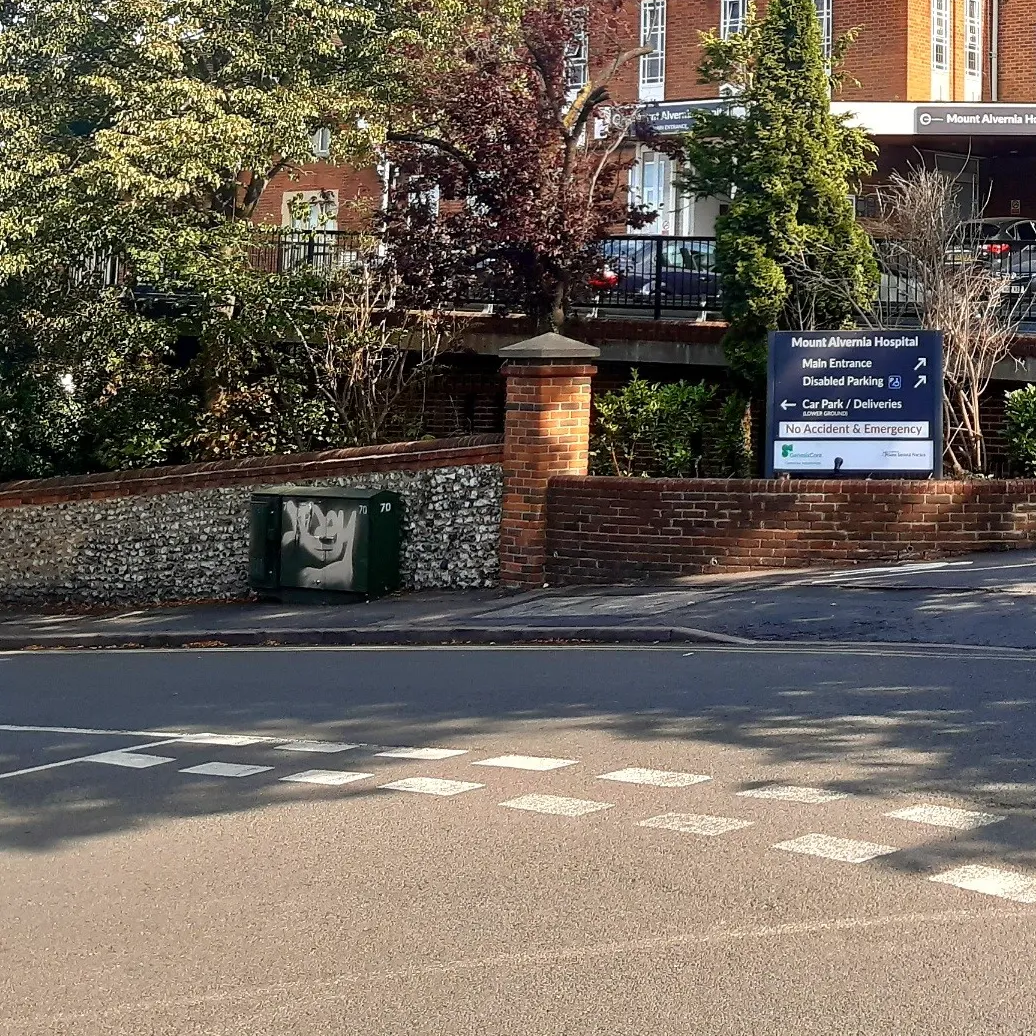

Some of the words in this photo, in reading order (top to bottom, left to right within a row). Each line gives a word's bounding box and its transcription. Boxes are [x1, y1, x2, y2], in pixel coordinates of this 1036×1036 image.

[946, 114, 980, 124] Mount
[981, 114, 1023, 124] Alvernia
[791, 337, 827, 348] Mount
[828, 337, 872, 348] Alvernia
[874, 336, 919, 349] Hospital
[802, 358, 827, 368] Main
[829, 358, 872, 368] Entrance
[803, 376, 845, 386] Disabled
[847, 376, 884, 388] Parking
[802, 399, 820, 409] Car
[822, 399, 844, 409] Park
[846, 399, 852, 409] /
[853, 399, 903, 409] Deliveries
[785, 424, 801, 434] No
[803, 424, 850, 434] Accident
[852, 424, 861, 434] &
[864, 424, 923, 436] Emergency
[359, 505, 368, 515] 70
[380, 503, 391, 513] 70
